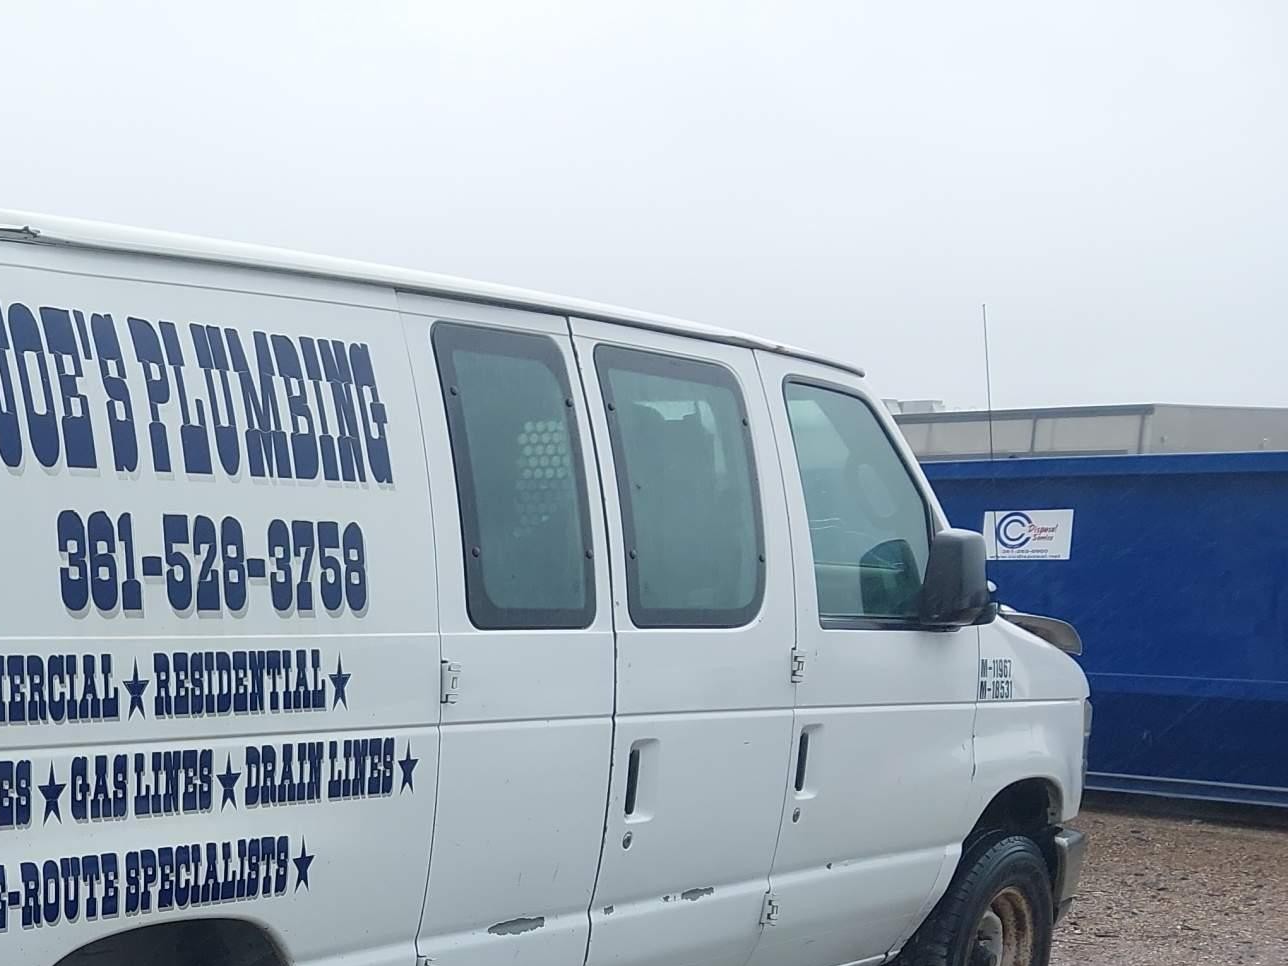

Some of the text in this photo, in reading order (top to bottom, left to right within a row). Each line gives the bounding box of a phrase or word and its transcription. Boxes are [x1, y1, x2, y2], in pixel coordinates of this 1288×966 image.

[127, 316, 395, 486] PLUMBING
[57, 509, 369, 614] 361-528-3758
[152, 649, 327, 717] RESIDENTIAL
[979, 680, 1013, 700] M-18531
[980, 658, 1012, 678] M-11967
[70, 752, 129, 823] GAS
[132, 747, 214, 817] LINES
[244, 741, 323, 808] DRAIN
[326, 736, 395, 798] LINES
[126, 835, 290, 916] SPECIALISTS
